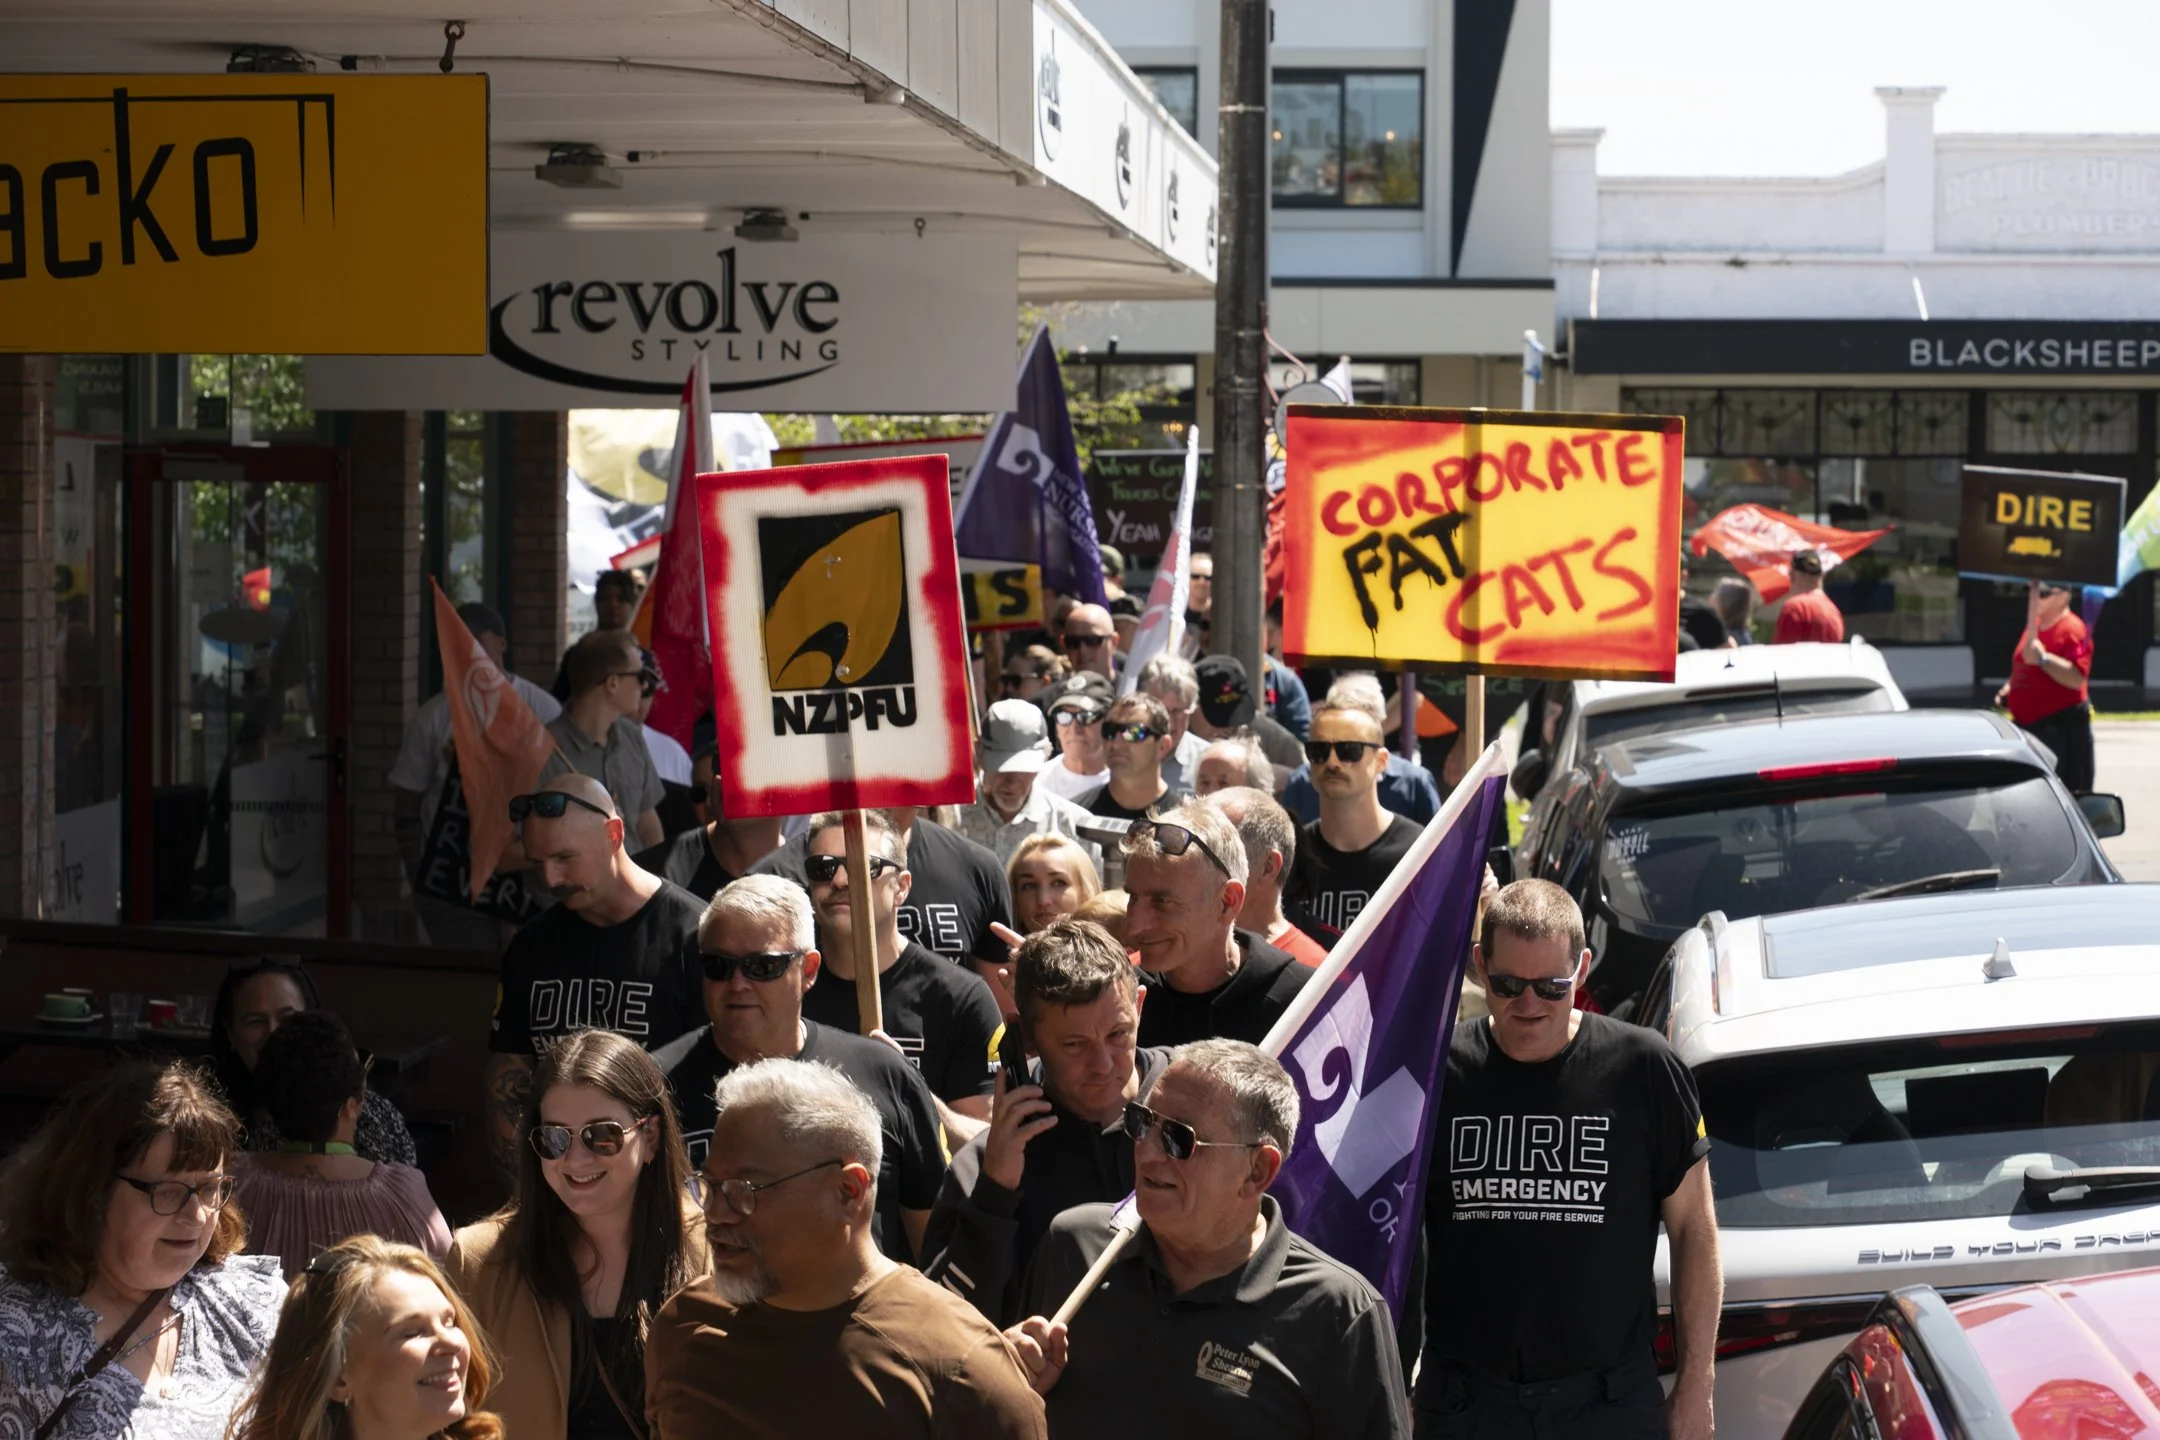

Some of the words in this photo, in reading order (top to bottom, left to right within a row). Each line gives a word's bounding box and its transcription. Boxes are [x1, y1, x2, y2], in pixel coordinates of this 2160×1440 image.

[1945, 159, 2052, 213] BEATTIE
[531, 248, 840, 334] revolve
[631, 339, 839, 362] STYLING
[1910, 339, 2160, 368] BLACKSHEEP
[1320, 430, 1658, 537] CORPORATE
[1996, 492, 2092, 532] DIRE
[1343, 508, 1471, 637] FAT
[1444, 526, 1655, 646] CATS
[771, 686, 918, 736] NZPFU
[1419, 677, 1526, 697] SERICE
[896, 903, 963, 951] RE
[529, 978, 653, 1035] DIRE
[1450, 1115, 1609, 1175] DIRE
[1451, 1178, 1607, 1202] EMERGENCY
[1452, 1210, 1491, 1221] FIGHTING
[1491, 1210, 1511, 1221] FOR
[1513, 1211, 1539, 1222] YOUR
[1540, 1212, 1562, 1222] FIRE
[1564, 1213, 1605, 1224] SERVICE
[1857, 1244, 1955, 1265] BUILD
[1967, 1238, 2062, 1257] YOUR
[1213, 1343, 1238, 1361] Peter
[1238, 1352, 1261, 1369] Lyon
